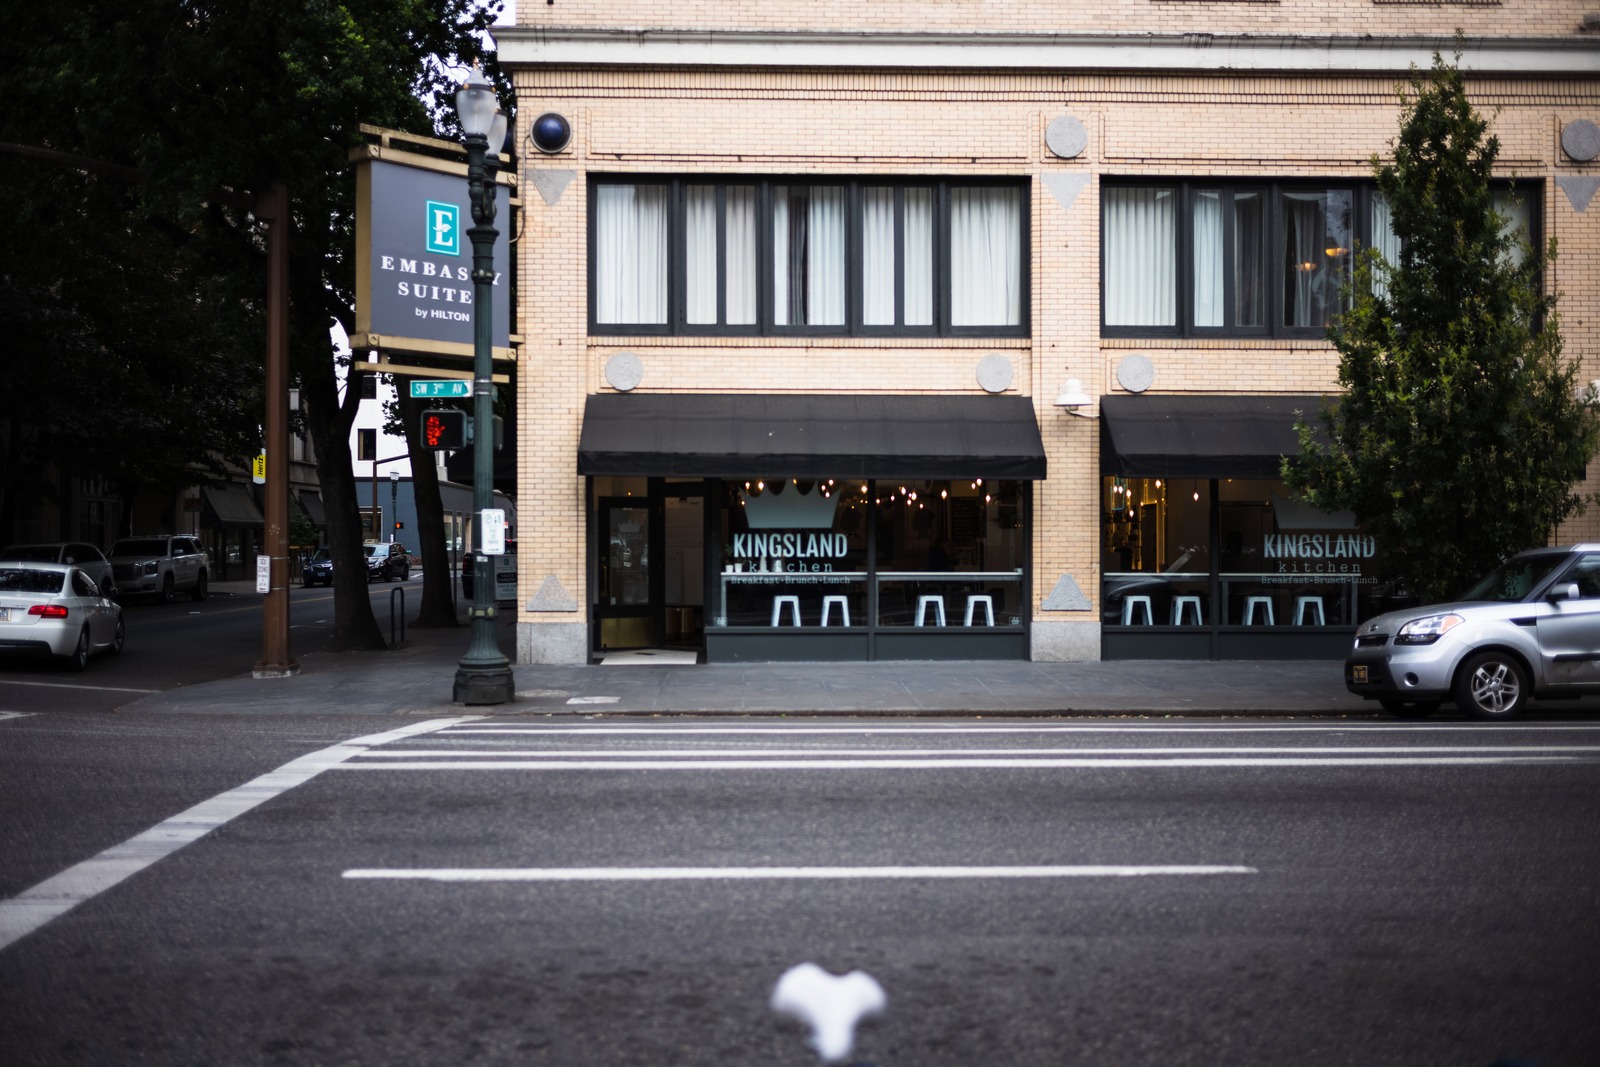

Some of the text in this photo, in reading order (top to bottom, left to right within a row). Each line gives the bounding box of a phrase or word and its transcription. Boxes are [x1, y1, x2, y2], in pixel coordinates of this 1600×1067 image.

[380, 255, 502, 286] EMBASY
[398, 281, 472, 304] SUITE
[415, 307, 470, 322] by HILTON
[415, 383, 428, 394] SW
[452, 383, 463, 394] AV
[733, 533, 848, 558] KINGSLAND
[1263, 534, 1376, 558] KINGSLAND
[1278, 561, 1361, 573] kitchen
